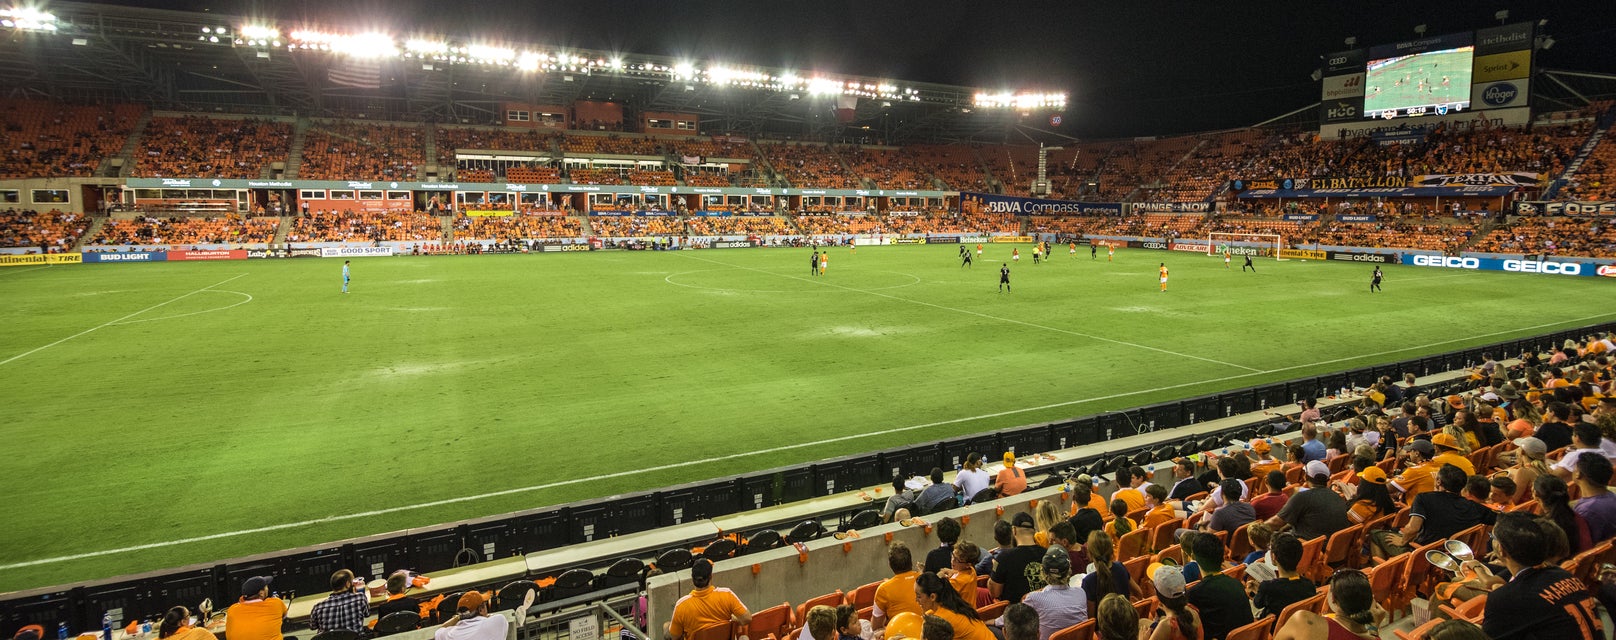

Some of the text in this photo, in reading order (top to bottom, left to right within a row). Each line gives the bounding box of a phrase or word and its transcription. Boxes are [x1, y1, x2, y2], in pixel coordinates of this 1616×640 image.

[1484, 64, 1507, 73] Sprint
[1486, 87, 1514, 104] Kroger
[1328, 107, 1355, 118] HCC
[1312, 179, 1329, 189] EL
[1440, 173, 1518, 186] TEXIAN
[989, 201, 1079, 216] BBVA Compass
[1133, 202, 1210, 211] ORANGE NOW
[960, 236, 988, 244] Heineken
[1176, 244, 1208, 252] ADVOCARE
[1215, 246, 1257, 256] Hneken
[247, 251, 275, 259] Lubys
[1353, 254, 1385, 262] adidas
[1413, 255, 1479, 269] GEICO
[1503, 259, 1580, 275] GEICO
